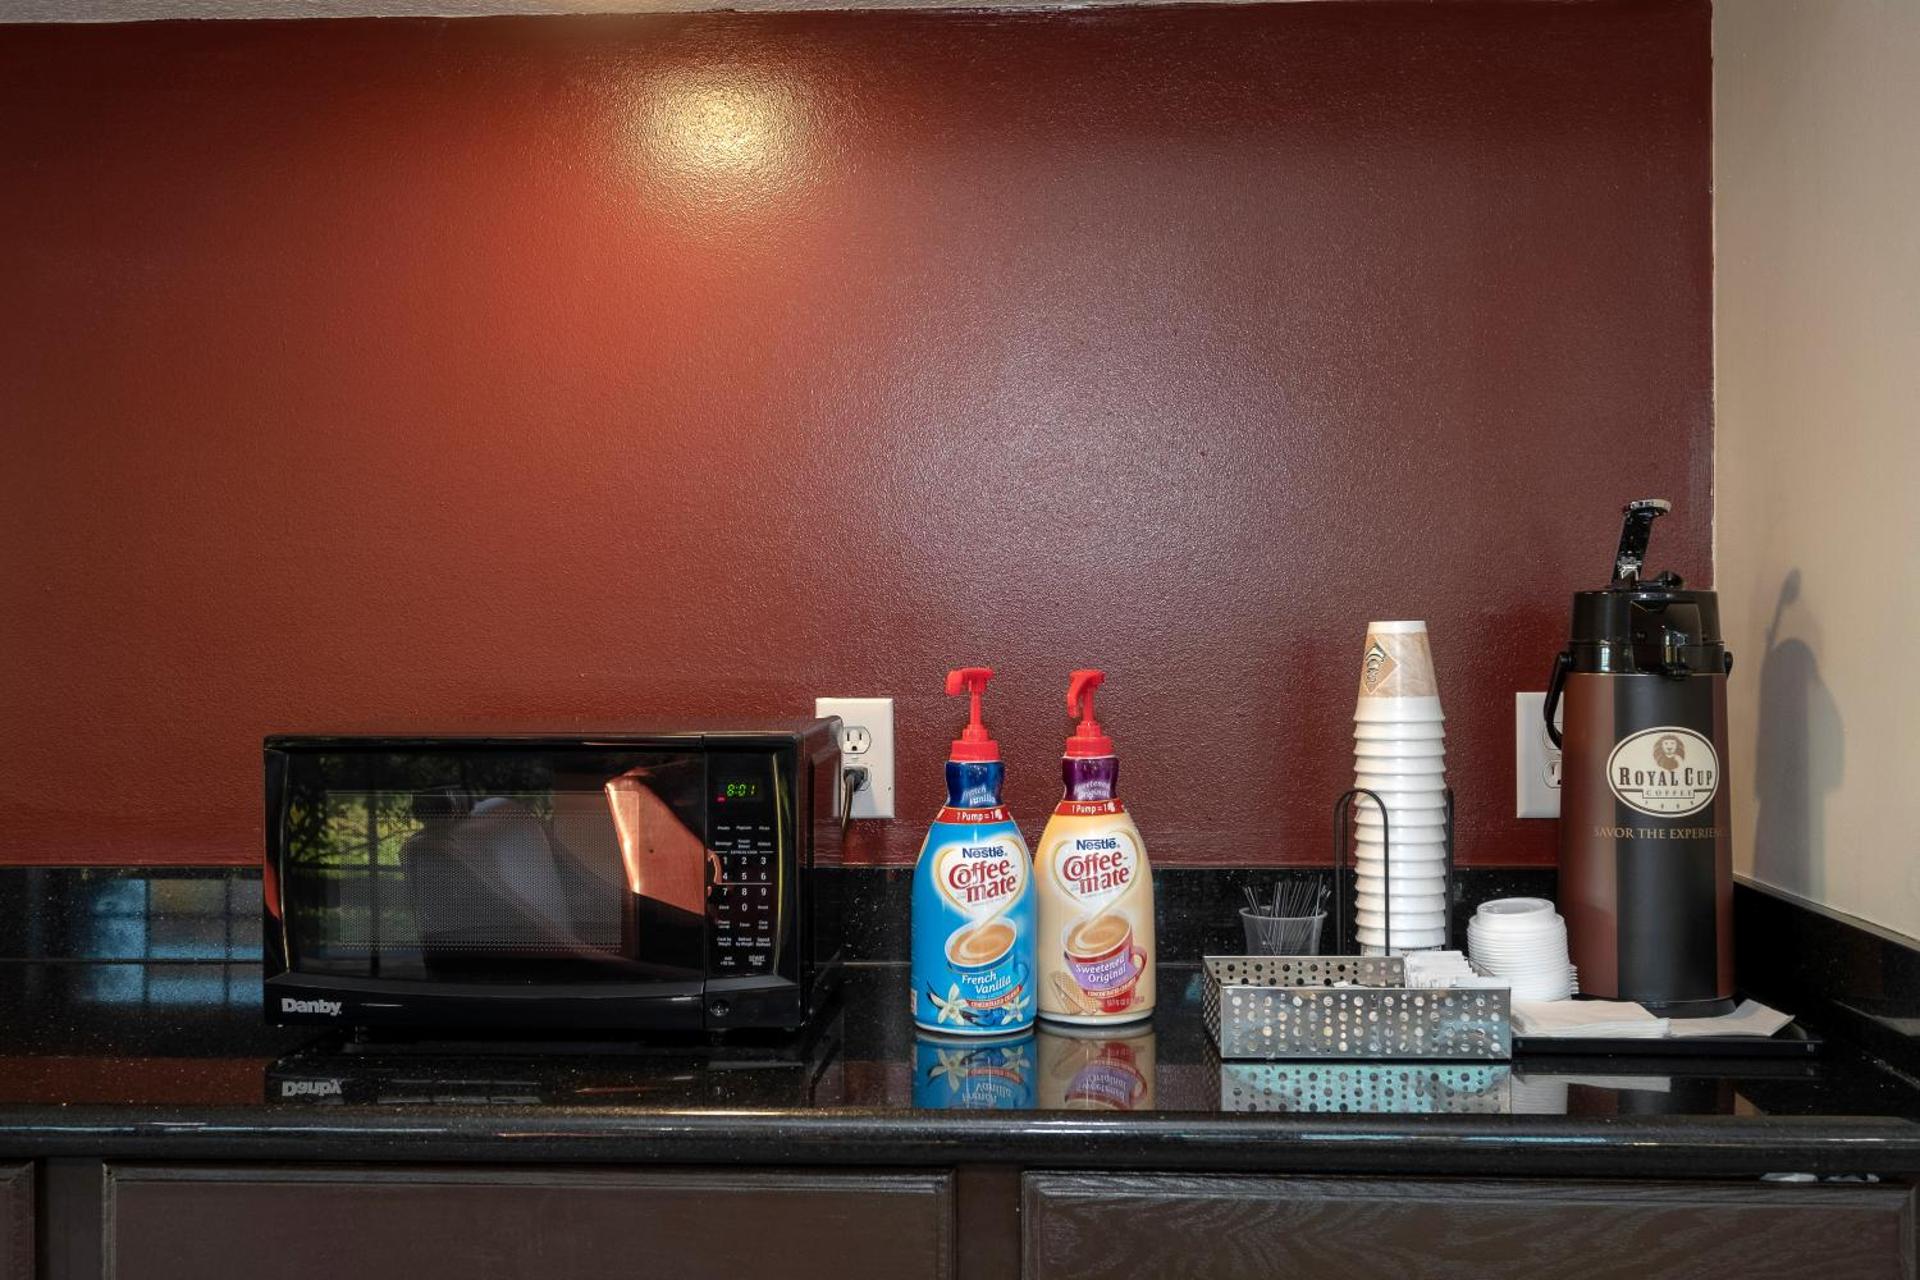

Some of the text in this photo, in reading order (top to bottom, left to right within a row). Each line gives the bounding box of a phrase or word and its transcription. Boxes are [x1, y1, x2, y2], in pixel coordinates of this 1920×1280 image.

[1619, 767, 1713, 786] ROYAL CUP
[727, 784, 756, 797] 8:01
[1076, 804, 1097, 815] Pump
[962, 812, 983, 822] Pump
[1596, 827, 1634, 839] SAVOR
[1638, 828, 1667, 839] THE
[741, 856, 747, 865] 2
[760, 856, 767, 865] 3
[722, 872, 767, 880] 4 5 6
[1079, 867, 1130, 894] mate
[722, 887, 767, 896] 7 8 9
[966, 875, 1017, 903] mate
[741, 903, 748, 912] 0
[1076, 953, 1126, 974] Sweetened
[962, 970, 997, 985] French
[1088, 963, 1127, 984] Original
[975, 976, 1011, 994] Vanilla
[281, 998, 341, 1016] Danby
